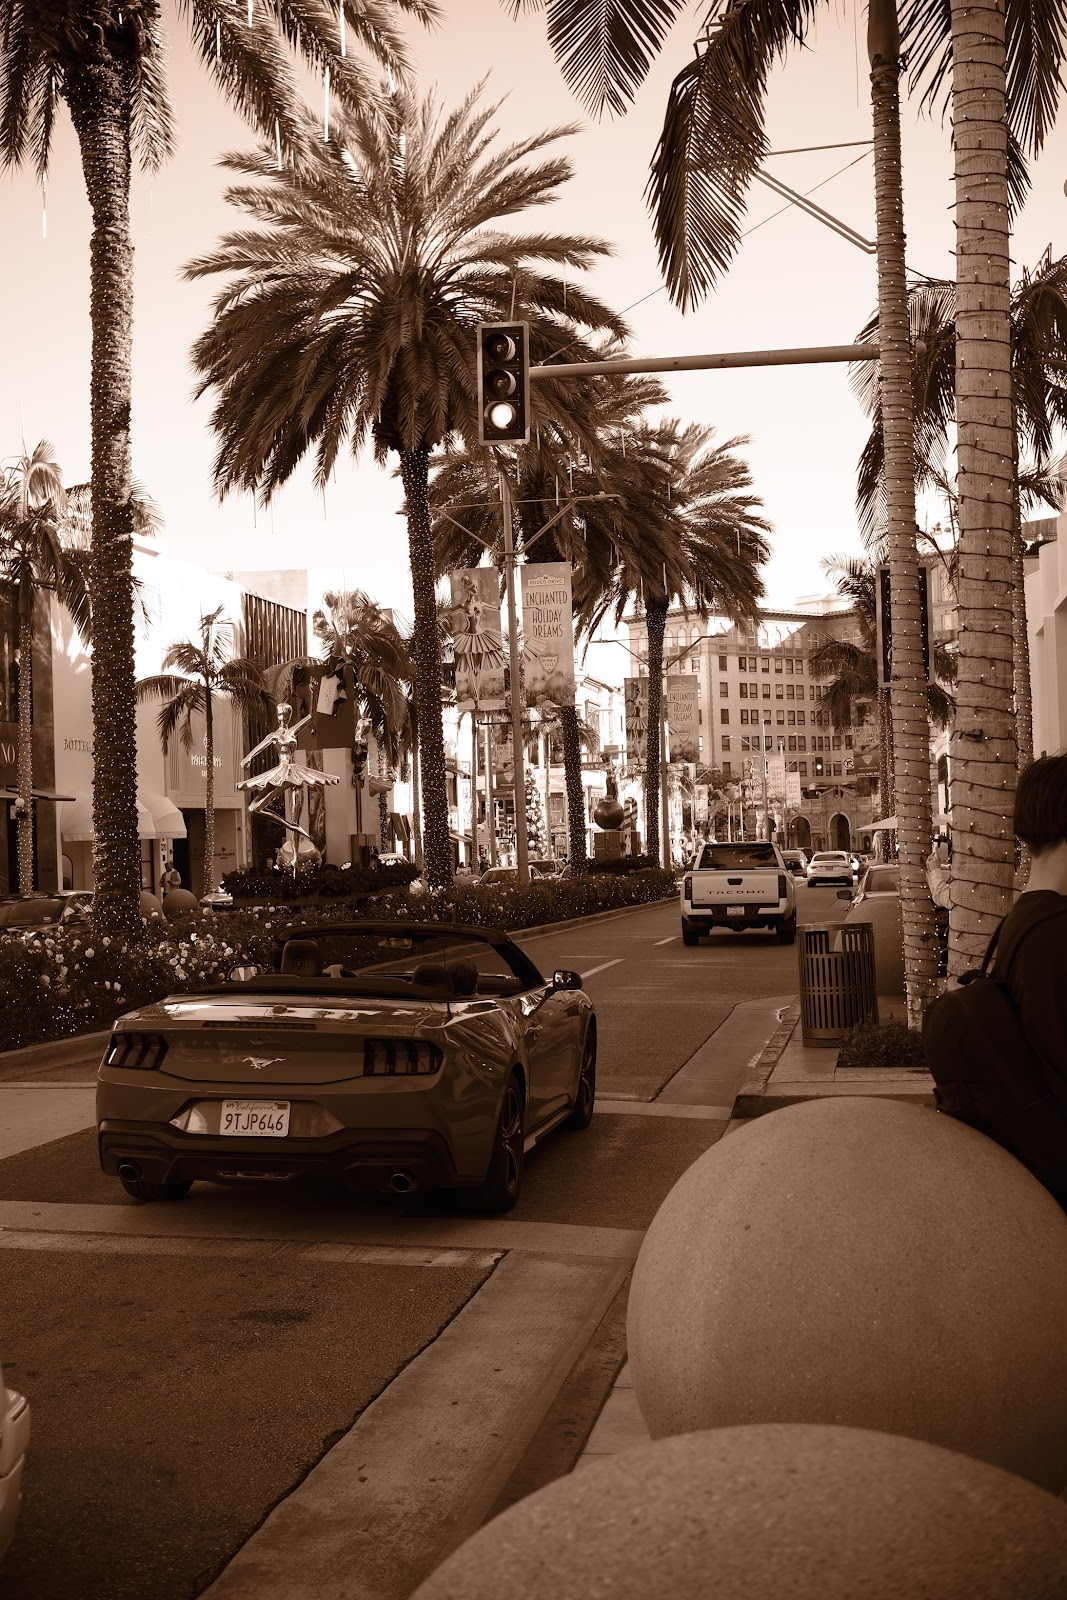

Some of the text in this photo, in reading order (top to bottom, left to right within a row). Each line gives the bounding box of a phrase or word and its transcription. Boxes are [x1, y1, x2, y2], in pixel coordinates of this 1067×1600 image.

[525, 590, 568, 606] ENCHANTED
[532, 608, 563, 624] HOLIDAY
[532, 623, 563, 638] DREAMS
[669, 692, 696, 701] ENCHANTED
[673, 703, 693, 713] HOLIDAY
[673, 712, 693, 721] DREAMS
[236, 1102, 277, 1113] California
[224, 1113, 284, 1131] 9TJP646
